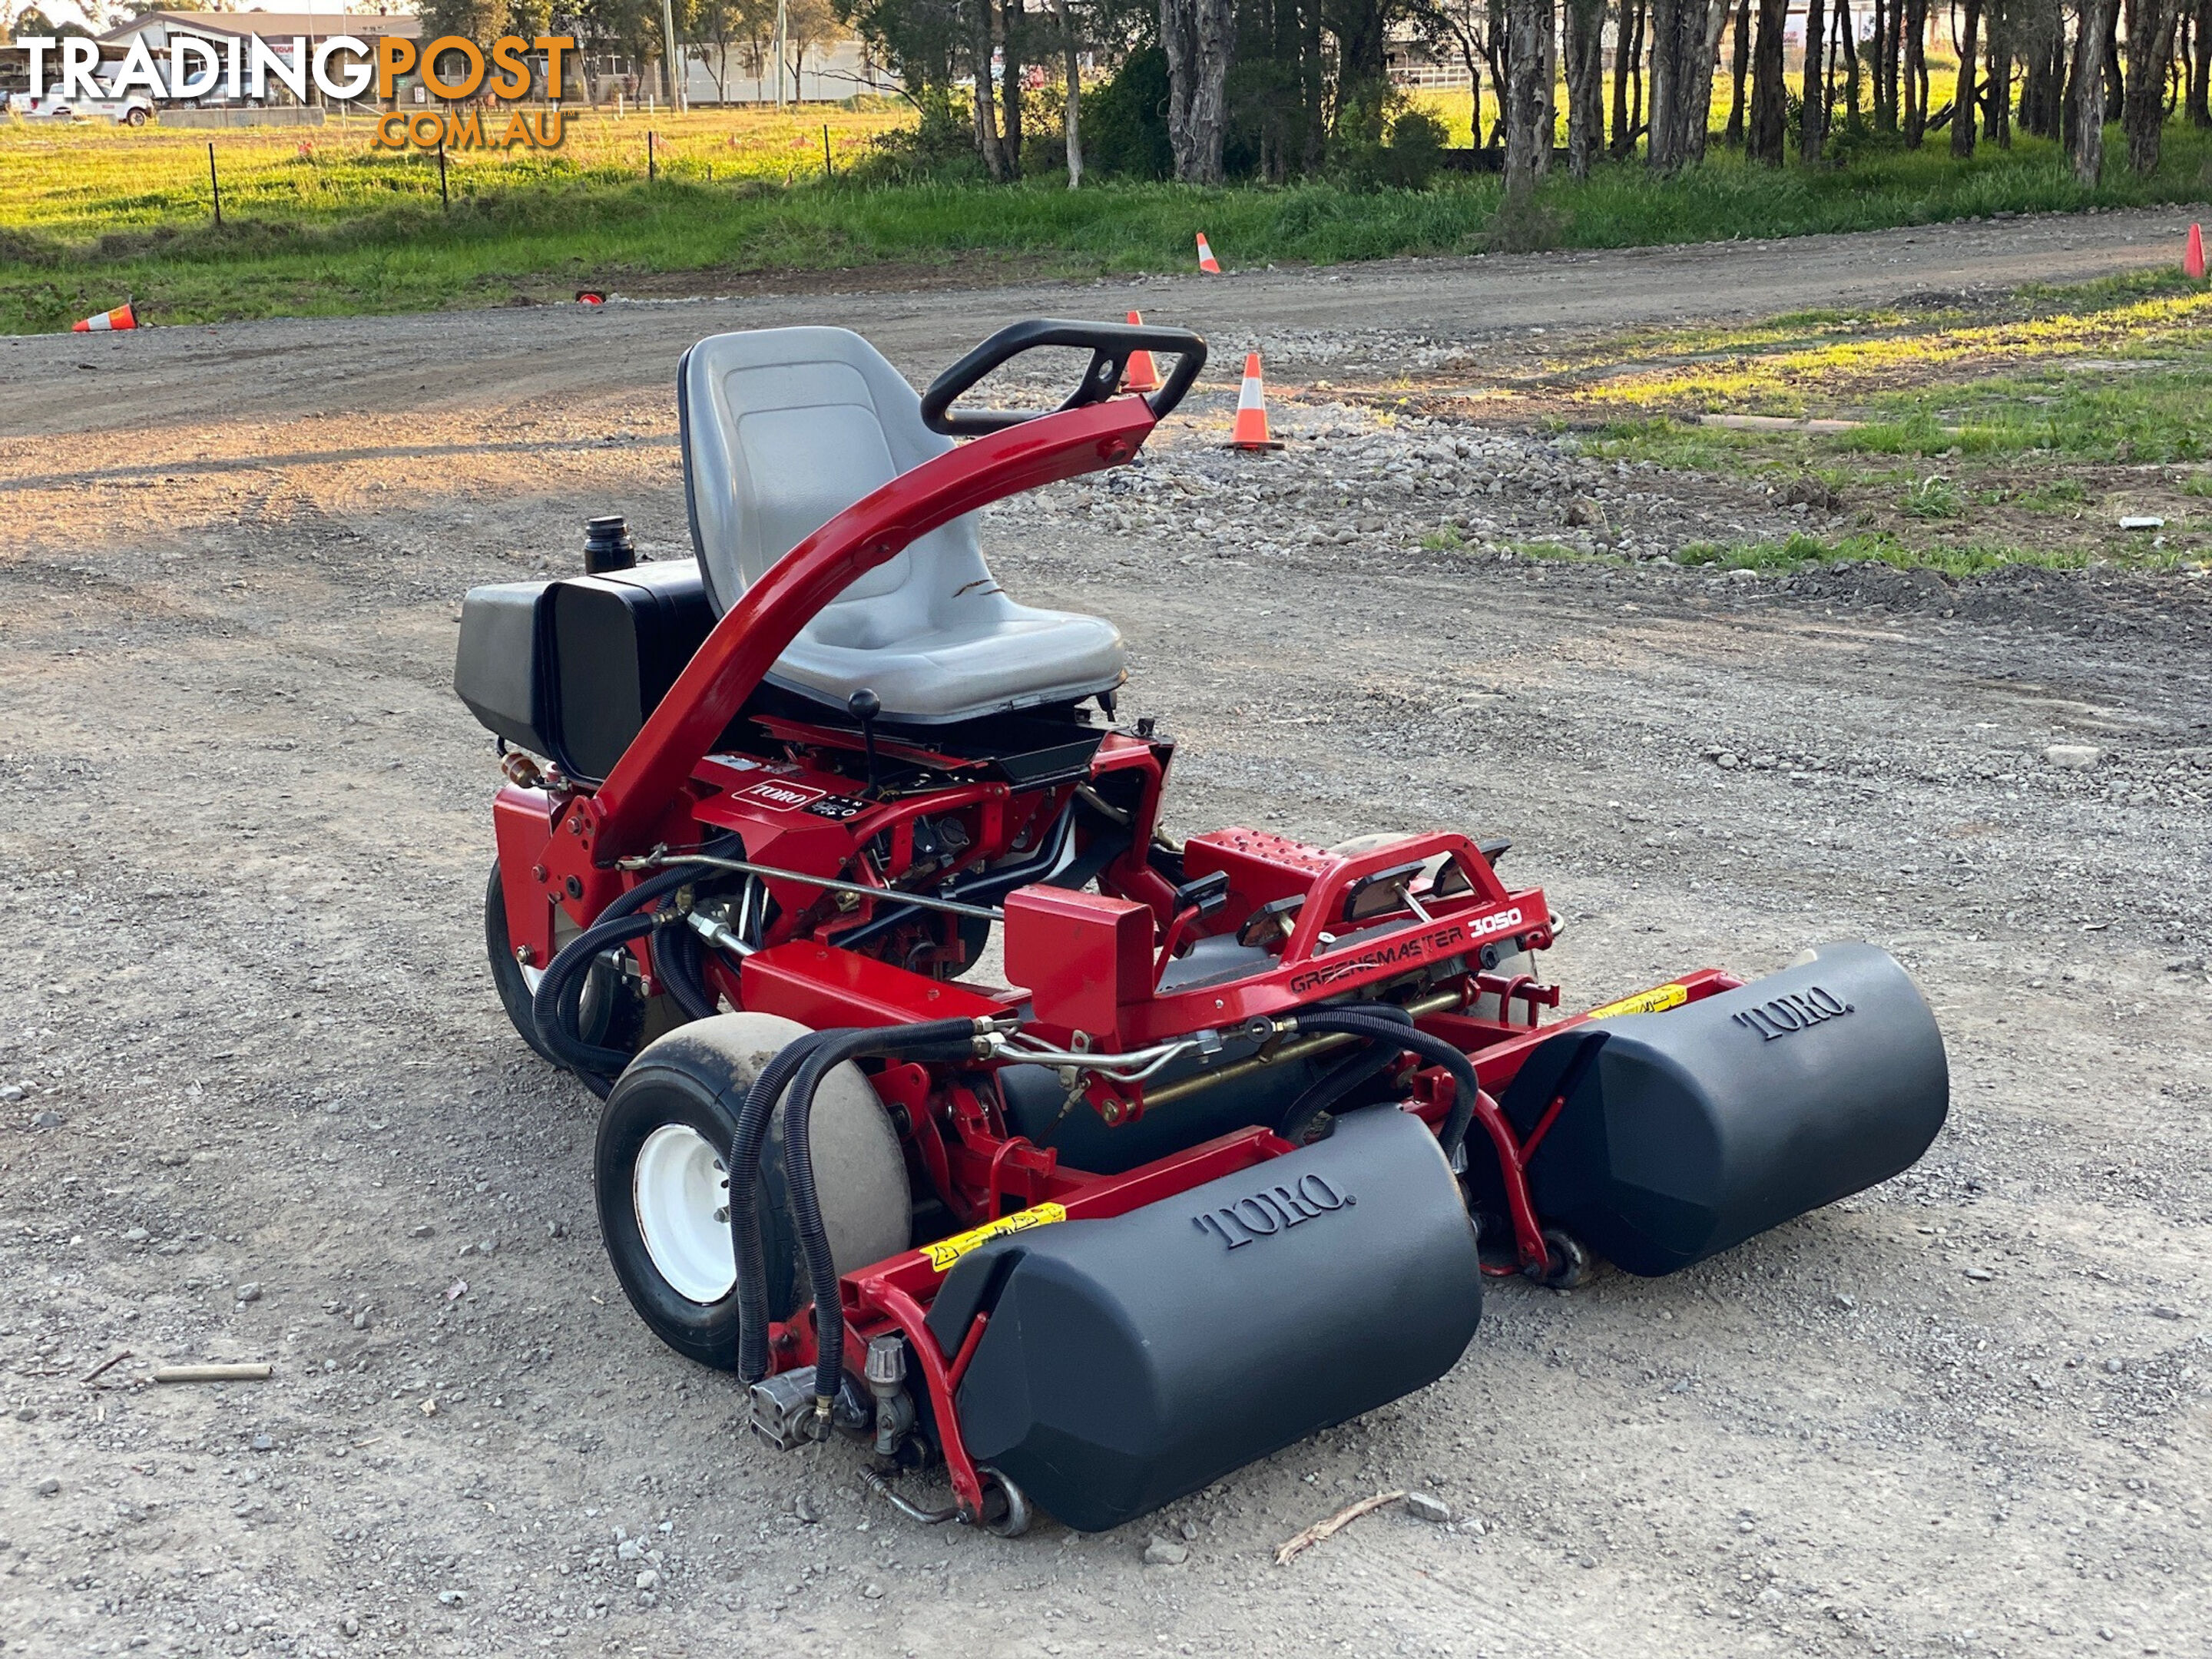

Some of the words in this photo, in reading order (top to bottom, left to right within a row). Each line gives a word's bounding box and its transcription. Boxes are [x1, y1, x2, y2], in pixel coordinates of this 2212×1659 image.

[750, 784, 806, 803] TORO
[1290, 926, 1464, 995] GREENSMASTER
[1468, 907, 1522, 939] 3050
